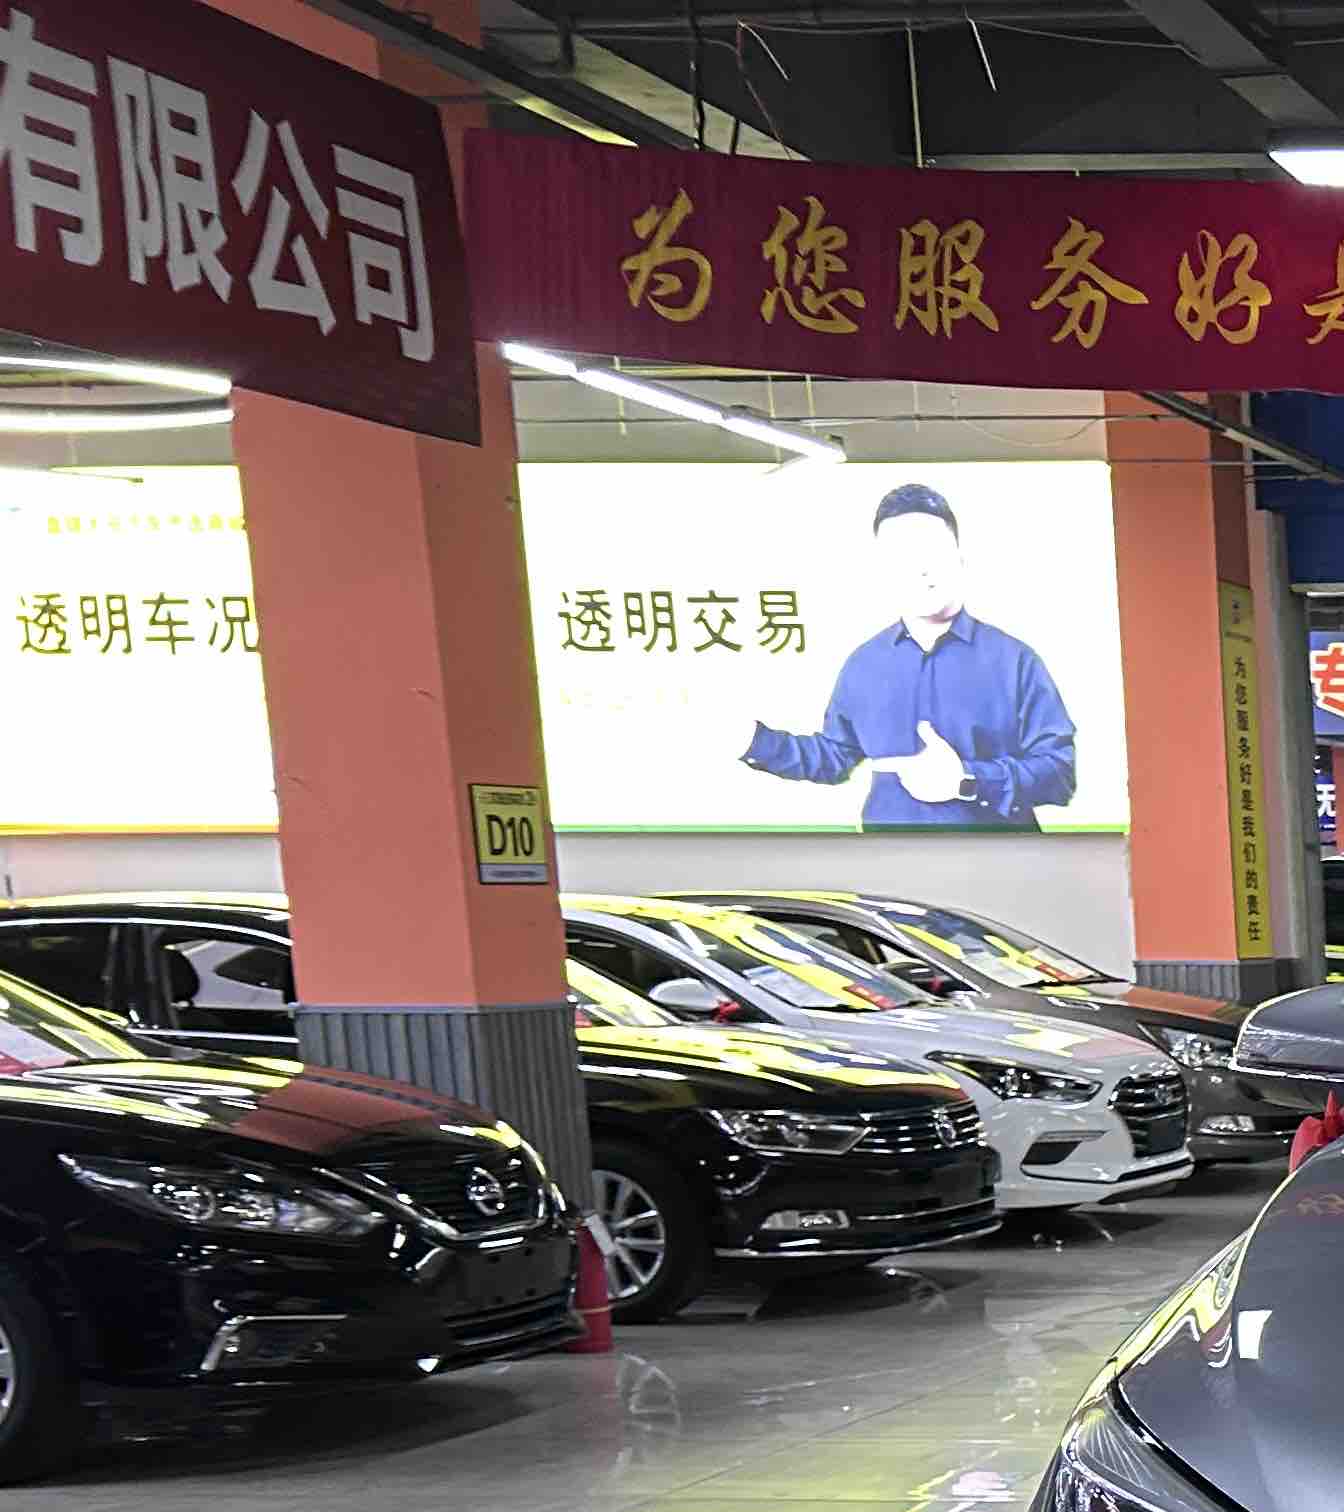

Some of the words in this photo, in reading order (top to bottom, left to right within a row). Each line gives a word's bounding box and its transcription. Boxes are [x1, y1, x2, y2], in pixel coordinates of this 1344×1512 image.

[0, 8, 435, 362] 有限公司
[15, 591, 259, 655] 透明车况
[558, 590, 806, 654] 透明交易
[485, 814, 534, 857] D10
